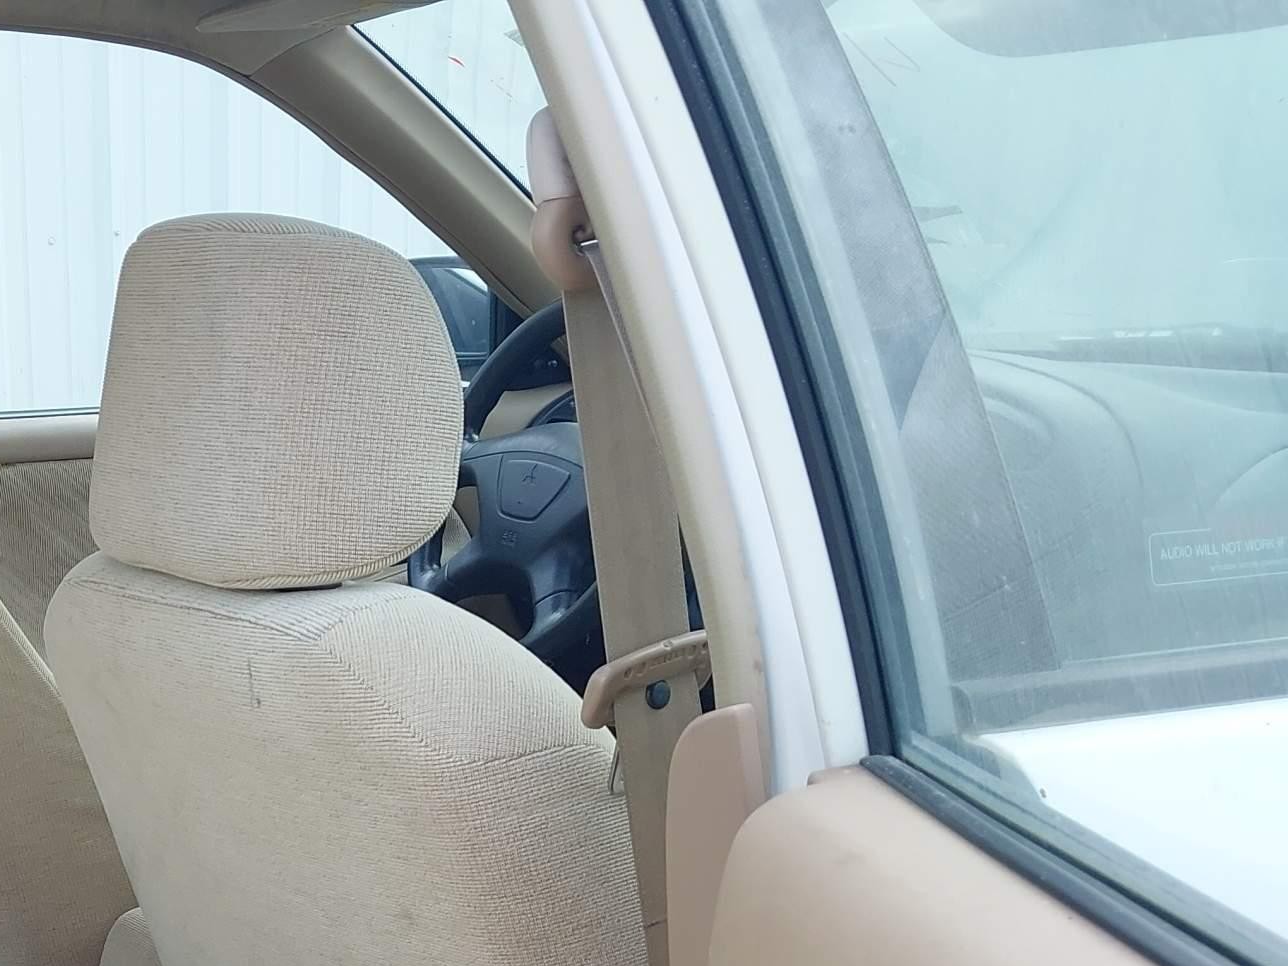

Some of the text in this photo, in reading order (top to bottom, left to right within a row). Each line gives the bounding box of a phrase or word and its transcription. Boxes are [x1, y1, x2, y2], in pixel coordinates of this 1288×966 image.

[1160, 544, 1193, 560] AUDIO
[1195, 543, 1219, 557] WILL
[1221, 541, 1242, 553] NOT
